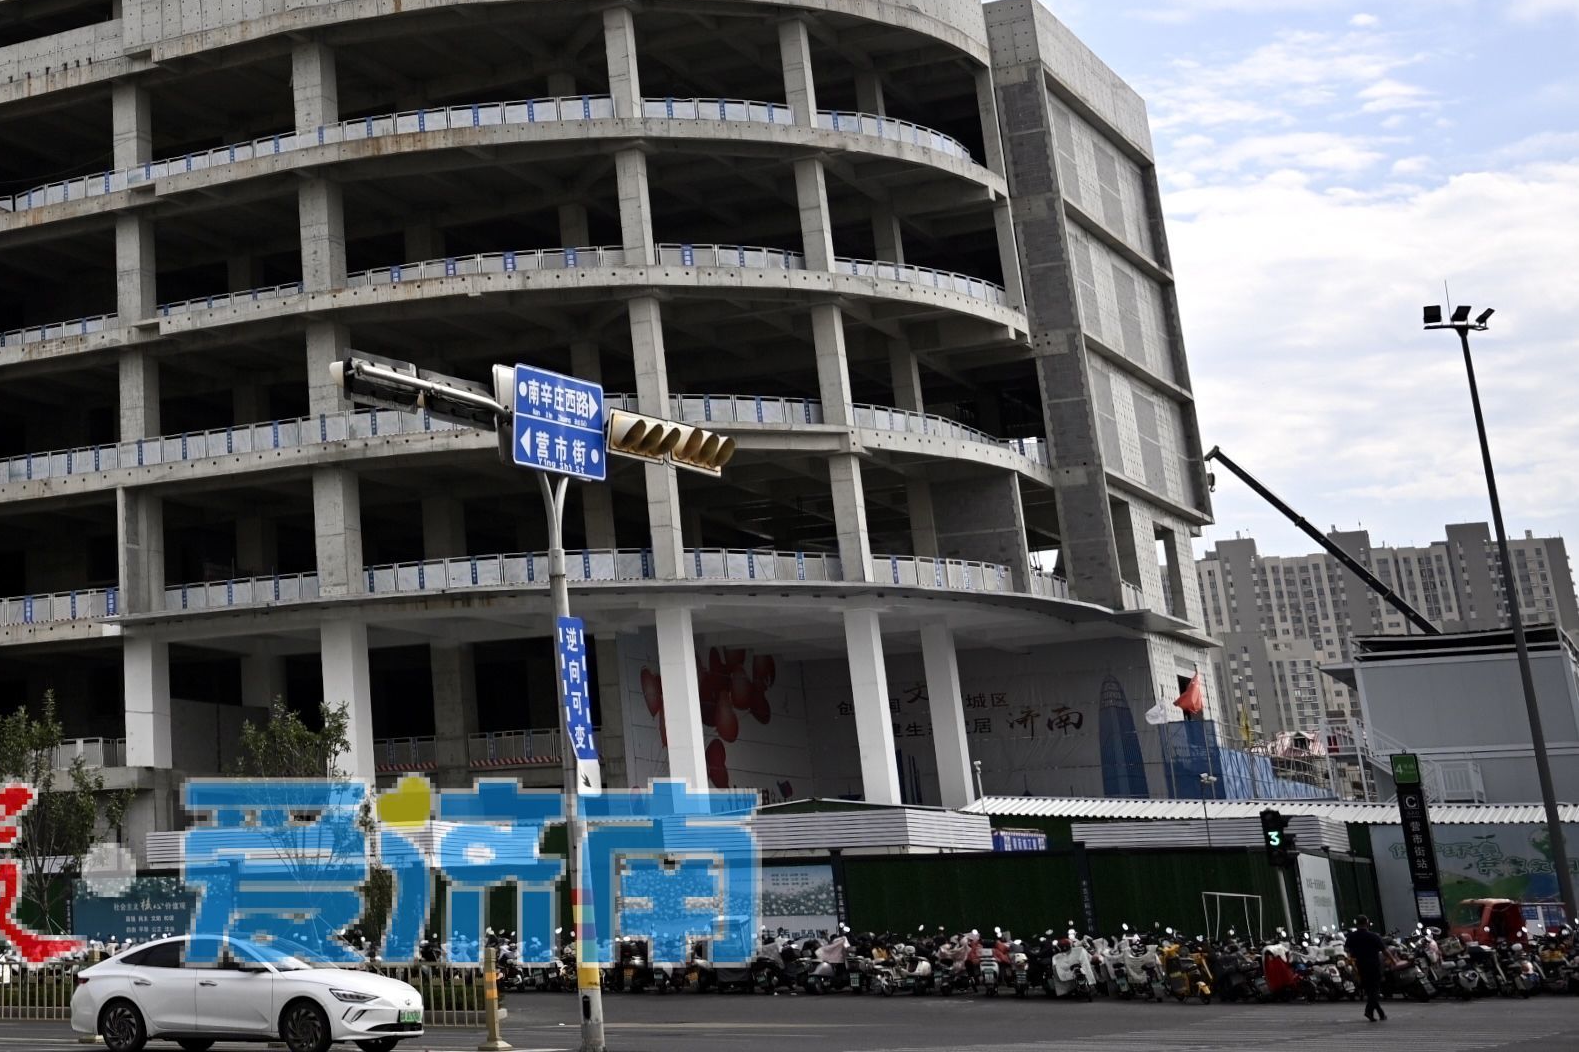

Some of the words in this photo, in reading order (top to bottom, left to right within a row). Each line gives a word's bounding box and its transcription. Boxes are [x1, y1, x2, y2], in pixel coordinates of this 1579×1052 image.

[527, 378, 589, 419] 南辛庄西路
[535, 430, 586, 467] 营市街
[565, 627, 586, 749] 逆向可变
[1404, 795, 1418, 809] C
[1267, 831, 1280, 846] 3
